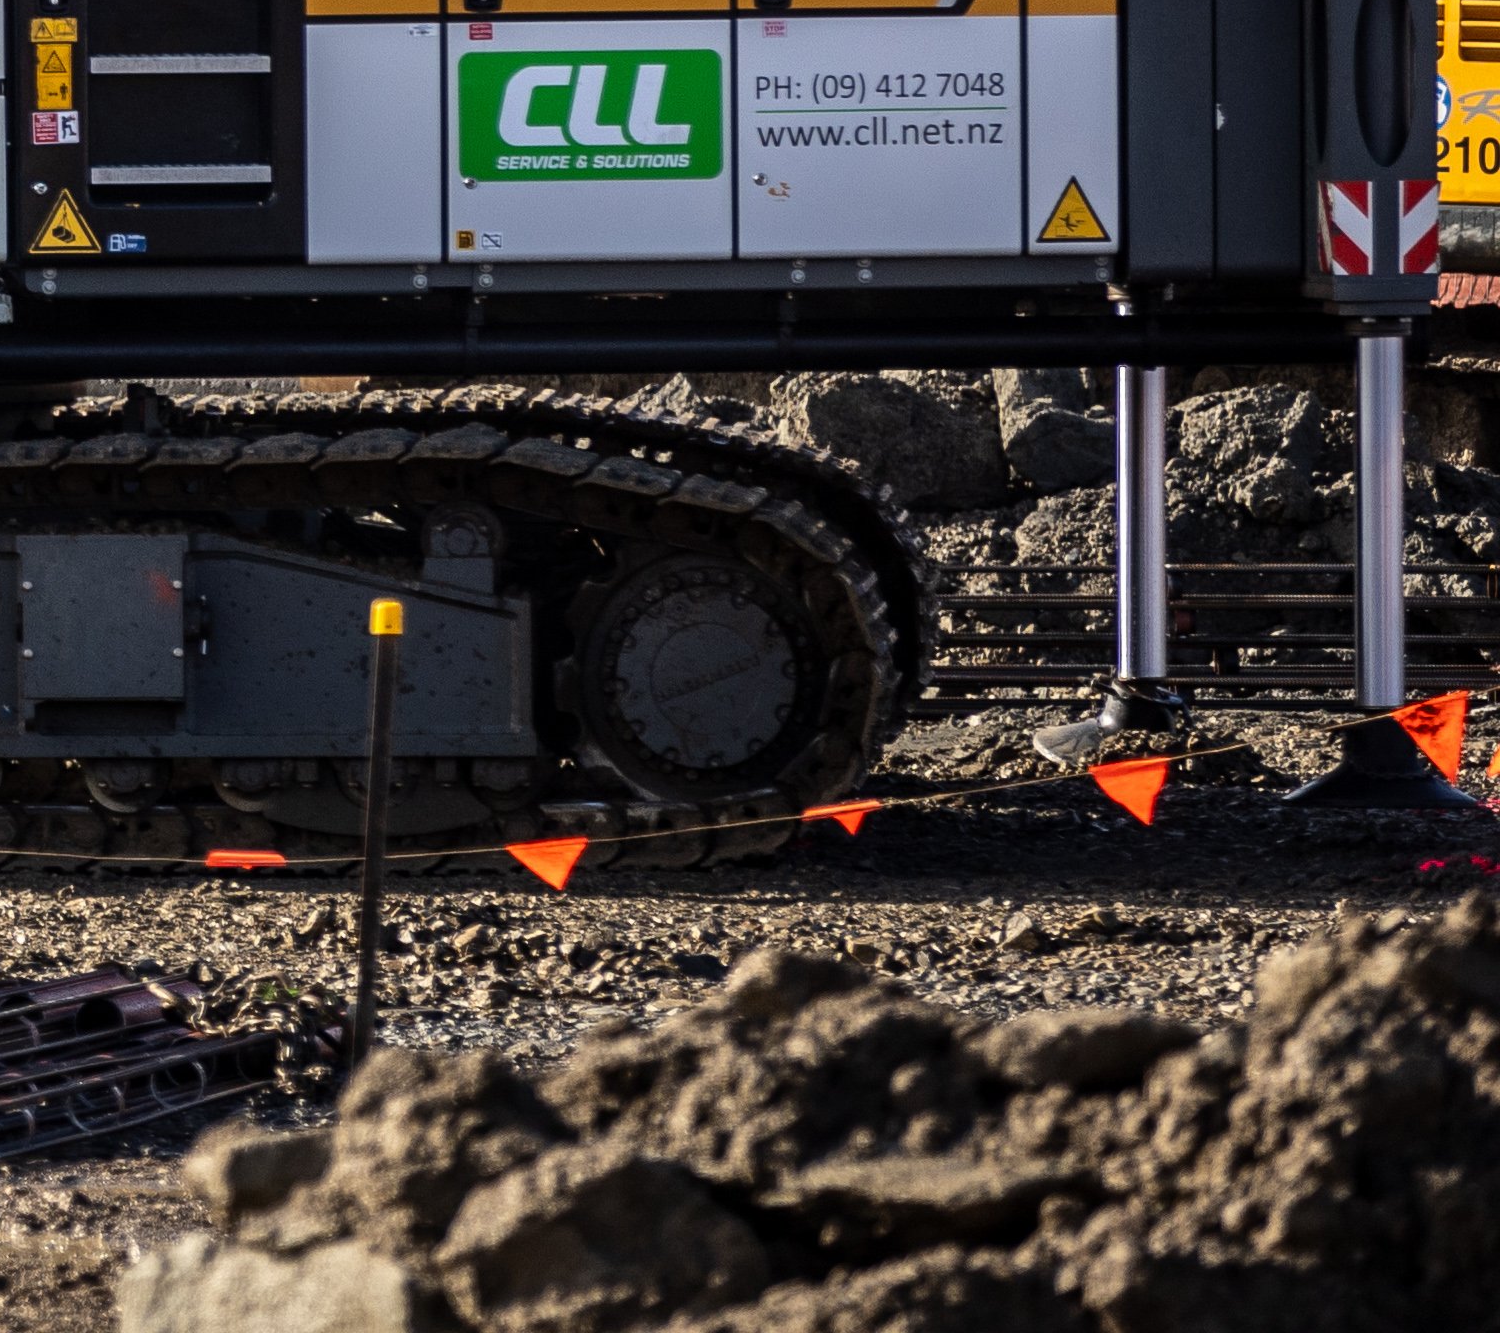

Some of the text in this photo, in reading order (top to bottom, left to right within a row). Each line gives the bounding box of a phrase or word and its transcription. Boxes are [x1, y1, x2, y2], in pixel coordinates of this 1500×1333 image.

[755, 72, 1005, 105] PH: (09) 412 7048
[499, 64, 691, 146] CLL
[757, 116, 1004, 147] www.cll.net.nz
[496, 153, 690, 170] SERVICE & SOLUTIONS
